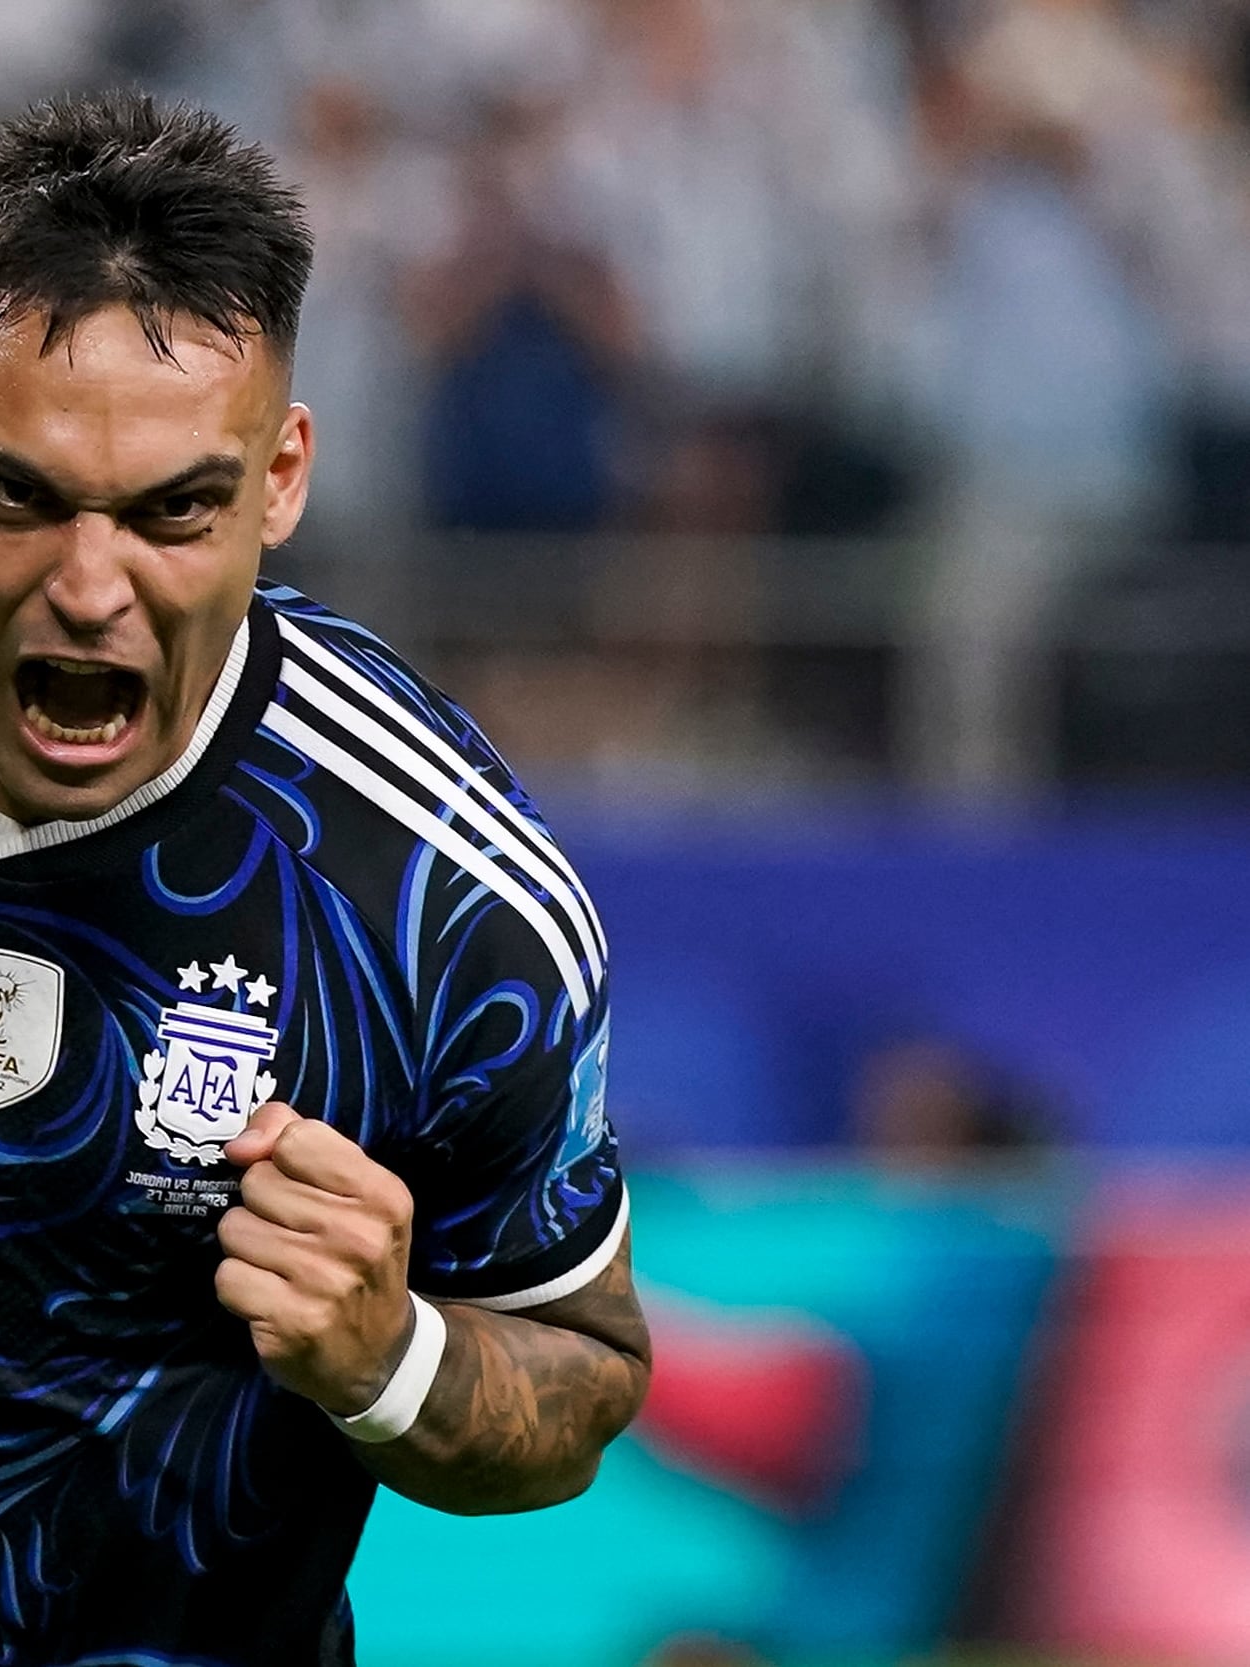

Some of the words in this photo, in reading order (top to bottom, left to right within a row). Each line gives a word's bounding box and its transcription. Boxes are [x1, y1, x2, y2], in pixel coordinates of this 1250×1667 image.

[167, 1047, 241, 1122] AFA
[125, 1171, 172, 1189] JORDAN
[174, 1178, 190, 1190] VS
[146, 1189, 163, 1201] 27
[165, 1191, 196, 1204] JUNE
[198, 1193, 229, 1207] 2026
[164, 1203, 208, 1217] DALLAS
